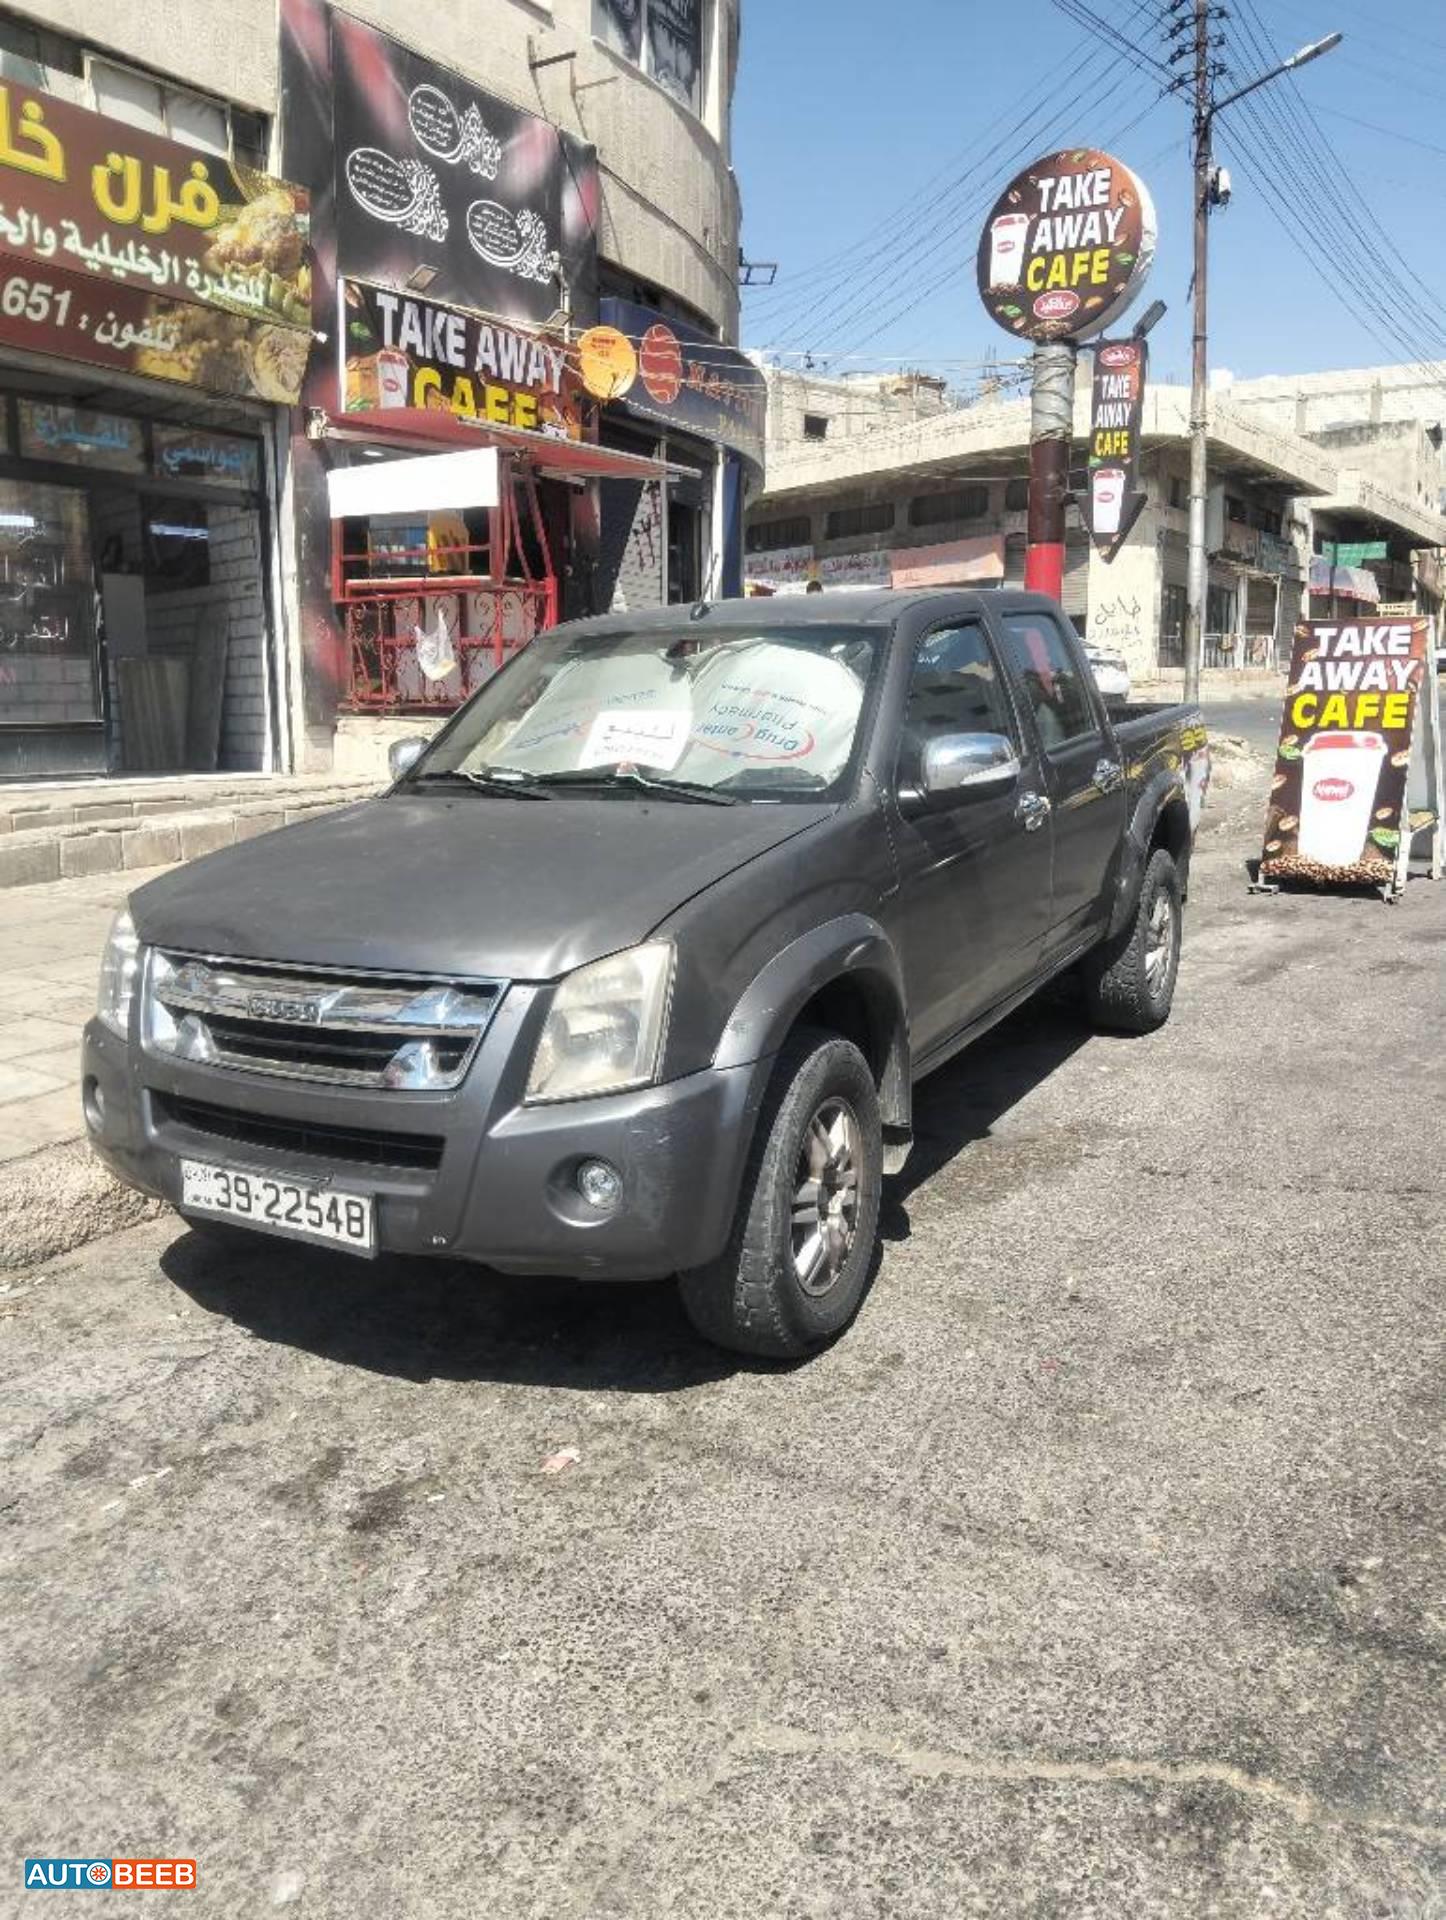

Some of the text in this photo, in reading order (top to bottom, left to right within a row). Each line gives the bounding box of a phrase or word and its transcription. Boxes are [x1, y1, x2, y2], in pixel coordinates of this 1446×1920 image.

[91, 151, 220, 234] فرن
[1037, 167, 1113, 213] TAKE
[1031, 207, 1125, 254] AWAY
[60, 219, 181, 285] الخليلية
[1026, 248, 1112, 292] CAFE
[376, 292, 568, 395] TAKE AWAY
[1101, 374, 1131, 399] TAKE
[1096, 402, 1132, 428] AWAY
[1093, 431, 1130, 457] CAFE
[1313, 624, 1412, 657] TAKE
[1299, 658, 1419, 692] AWAY
[1291, 692, 1411, 729] CAFE
[753, 728, 799, 751] Drug
